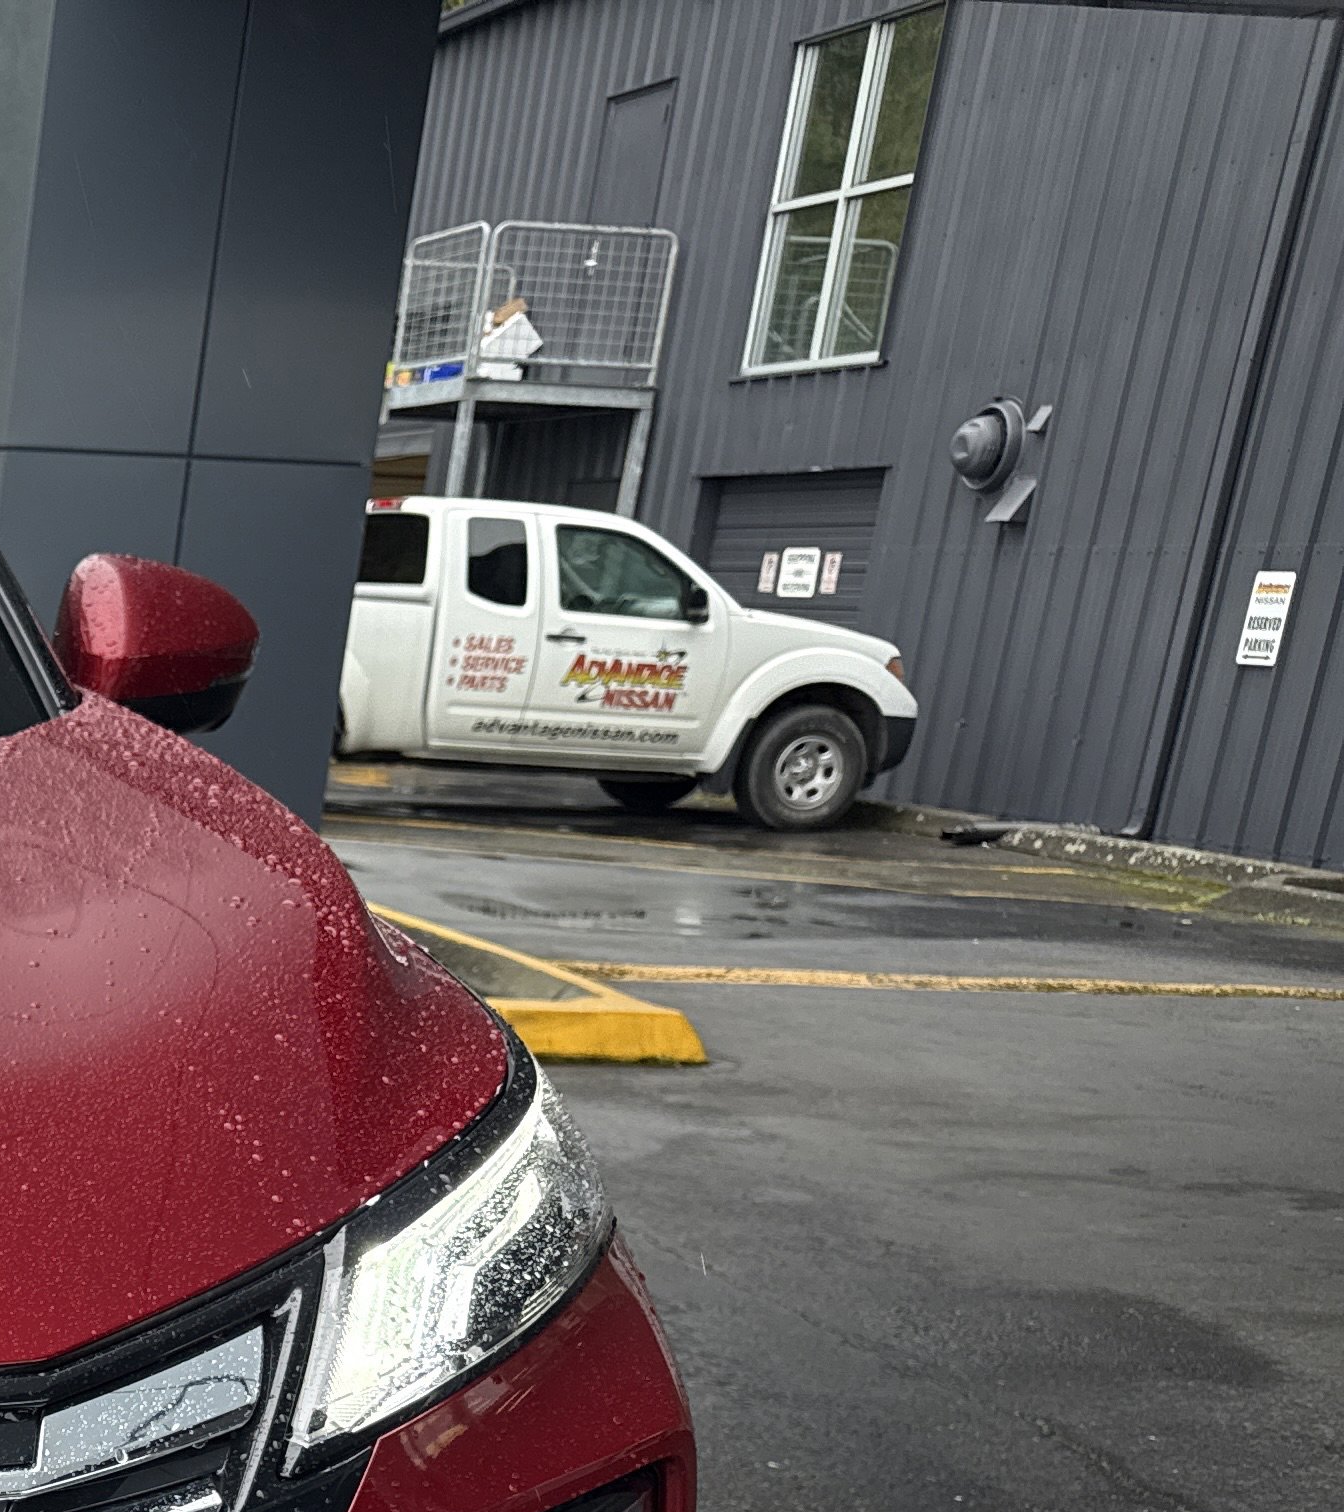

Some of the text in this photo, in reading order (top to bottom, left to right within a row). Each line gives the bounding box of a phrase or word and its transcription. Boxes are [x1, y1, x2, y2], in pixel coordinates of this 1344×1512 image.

[1248, 616, 1282, 631] RESERVED
[1243, 638, 1275, 653] PARKING
[601, 690, 676, 711] NISSAN
